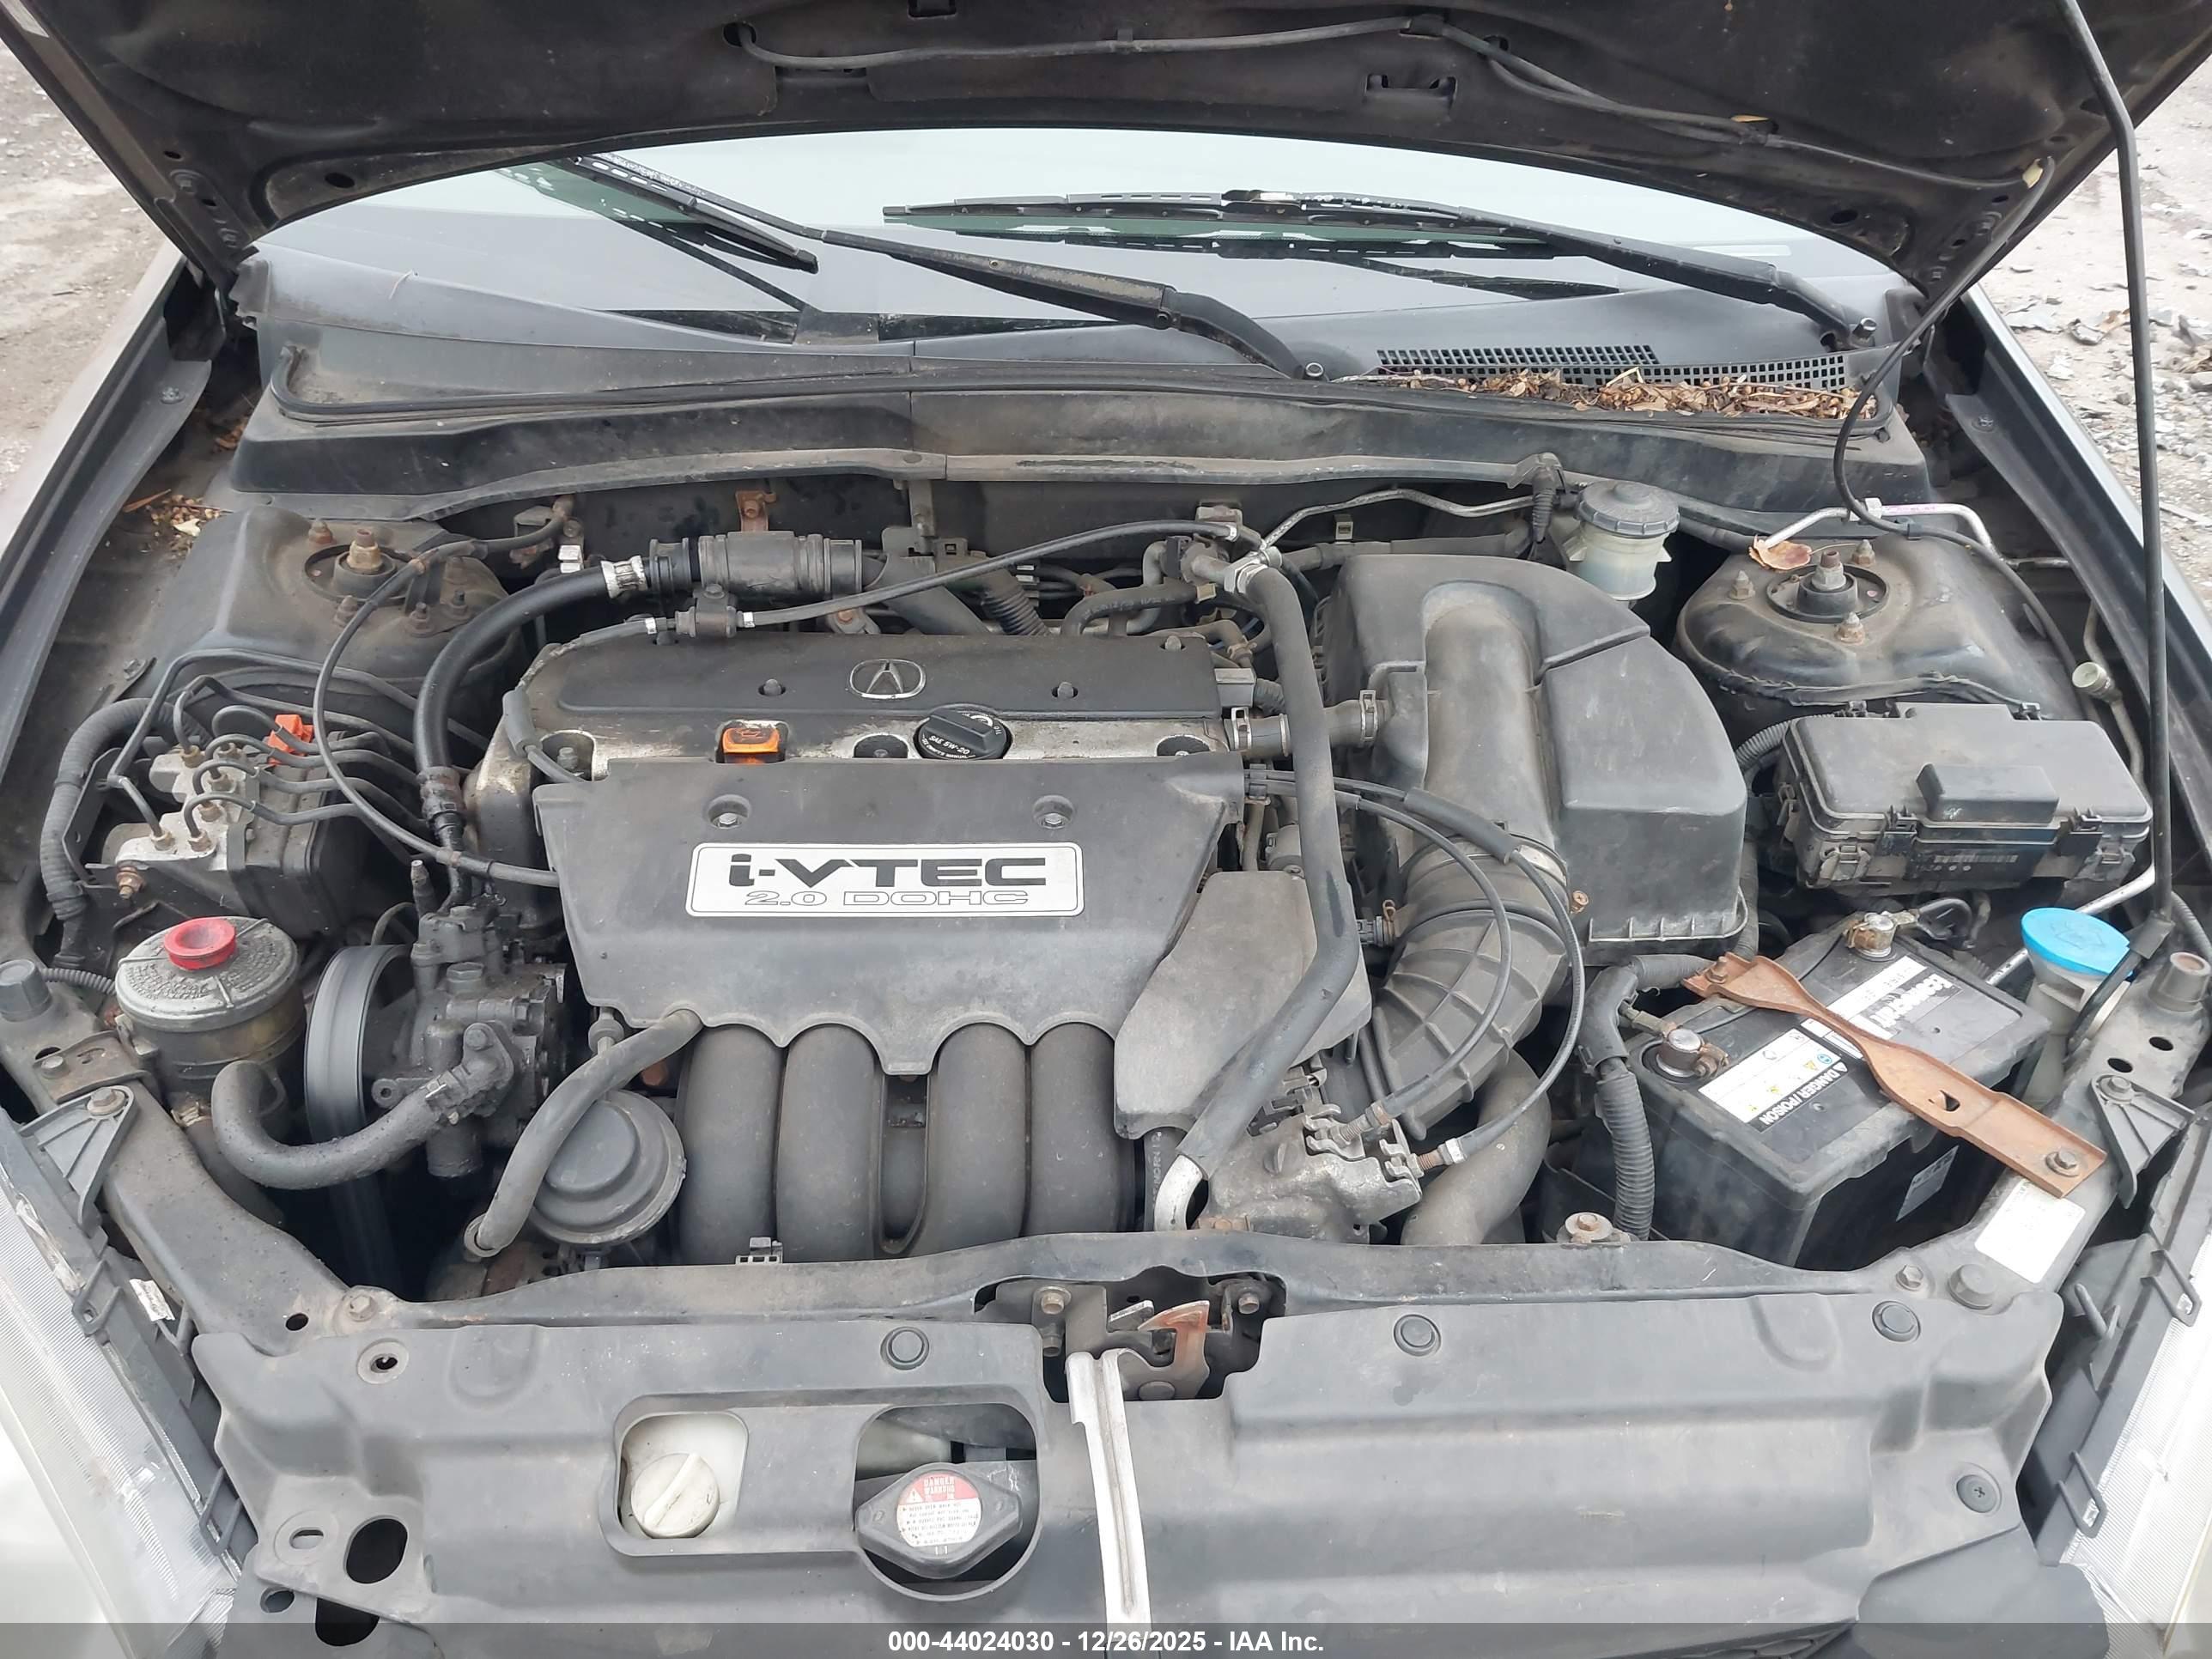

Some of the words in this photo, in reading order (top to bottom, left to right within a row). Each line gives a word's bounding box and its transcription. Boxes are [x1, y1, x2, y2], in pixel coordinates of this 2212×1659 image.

[928, 735, 945, 744] SAE
[943, 741, 970, 755] 5W-20
[728, 854, 1046, 888] i-VTEC
[744, 890, 827, 906] 2.0
[843, 890, 1029, 906] DOHC
[1799, 1068, 1840, 1099] DANGER
